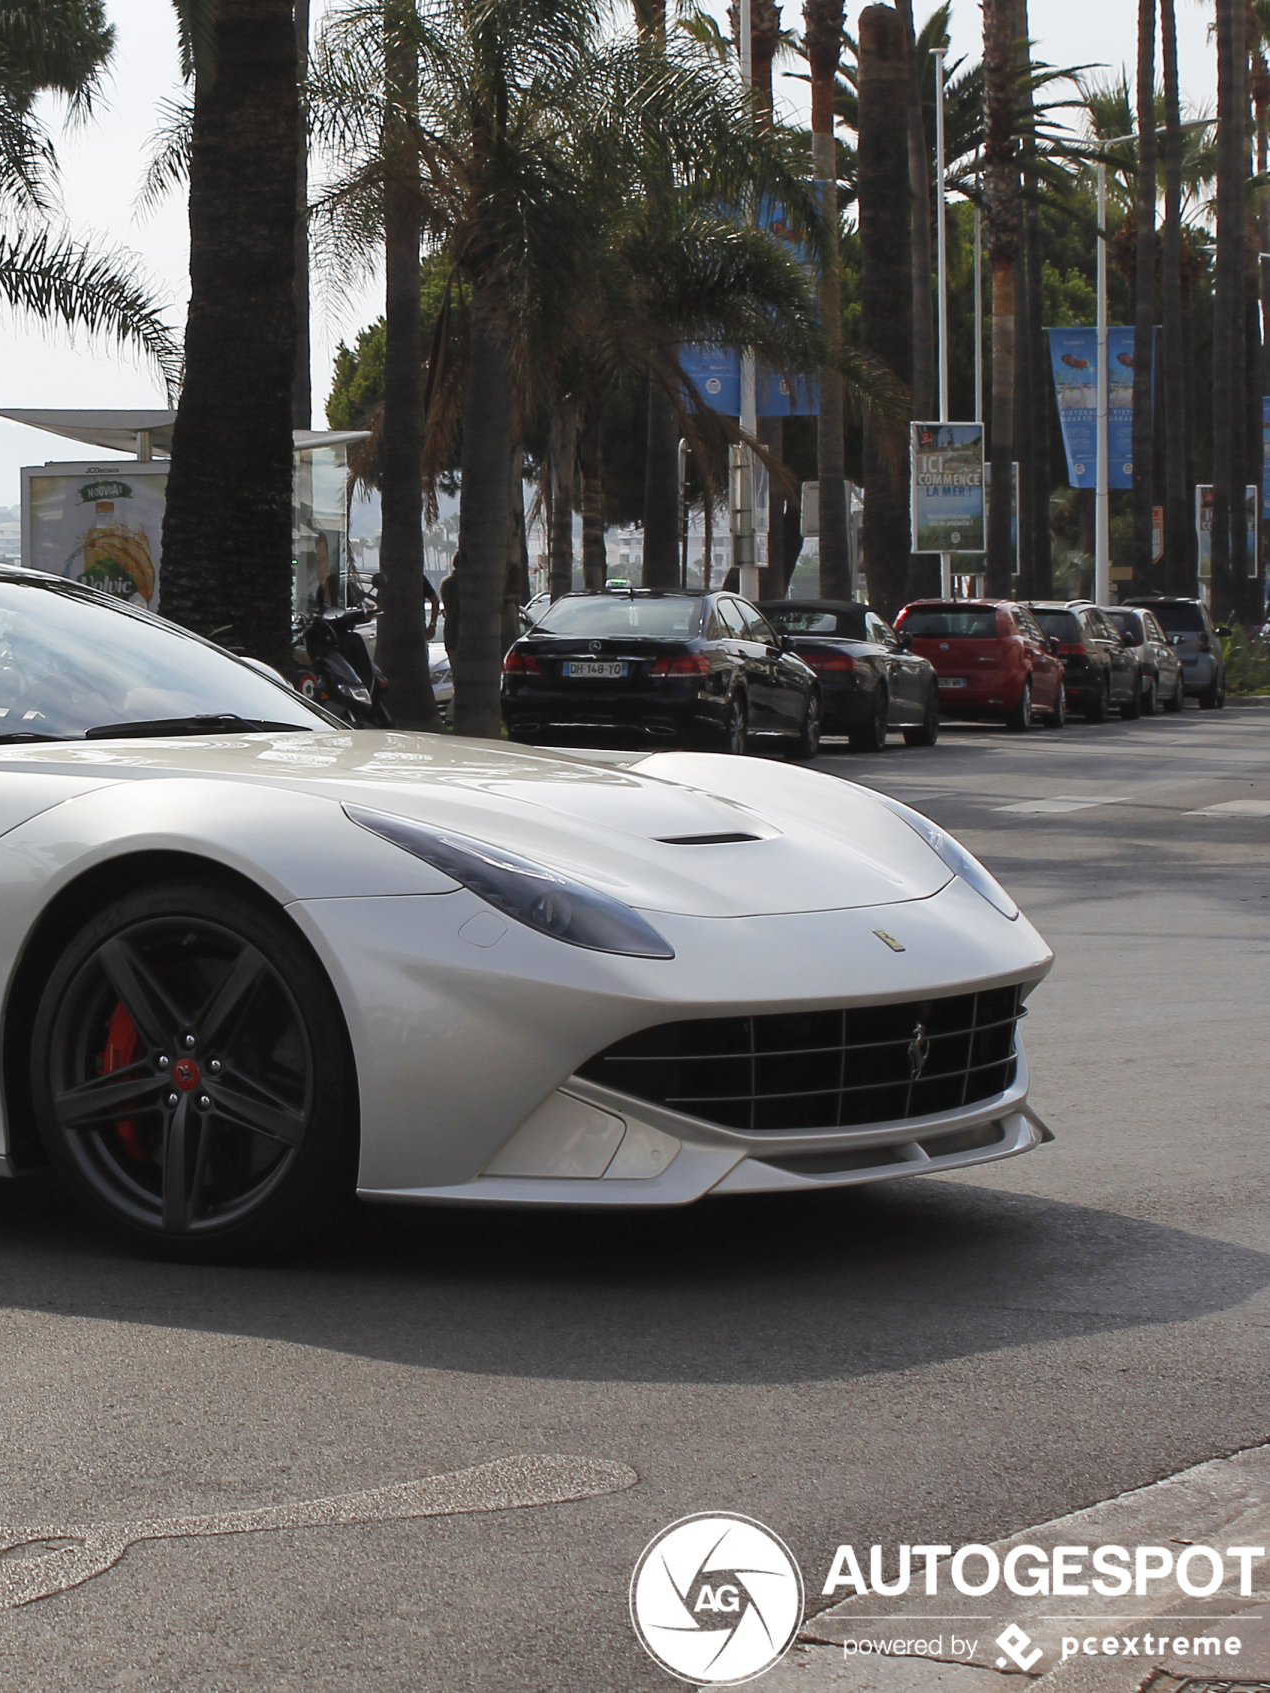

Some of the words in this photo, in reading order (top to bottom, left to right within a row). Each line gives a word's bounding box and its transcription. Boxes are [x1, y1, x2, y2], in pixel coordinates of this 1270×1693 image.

[922, 456, 943, 473] ICI
[918, 474, 981, 486] COMMENCE
[926, 486, 939, 498] LA
[942, 486, 965, 498] MER
